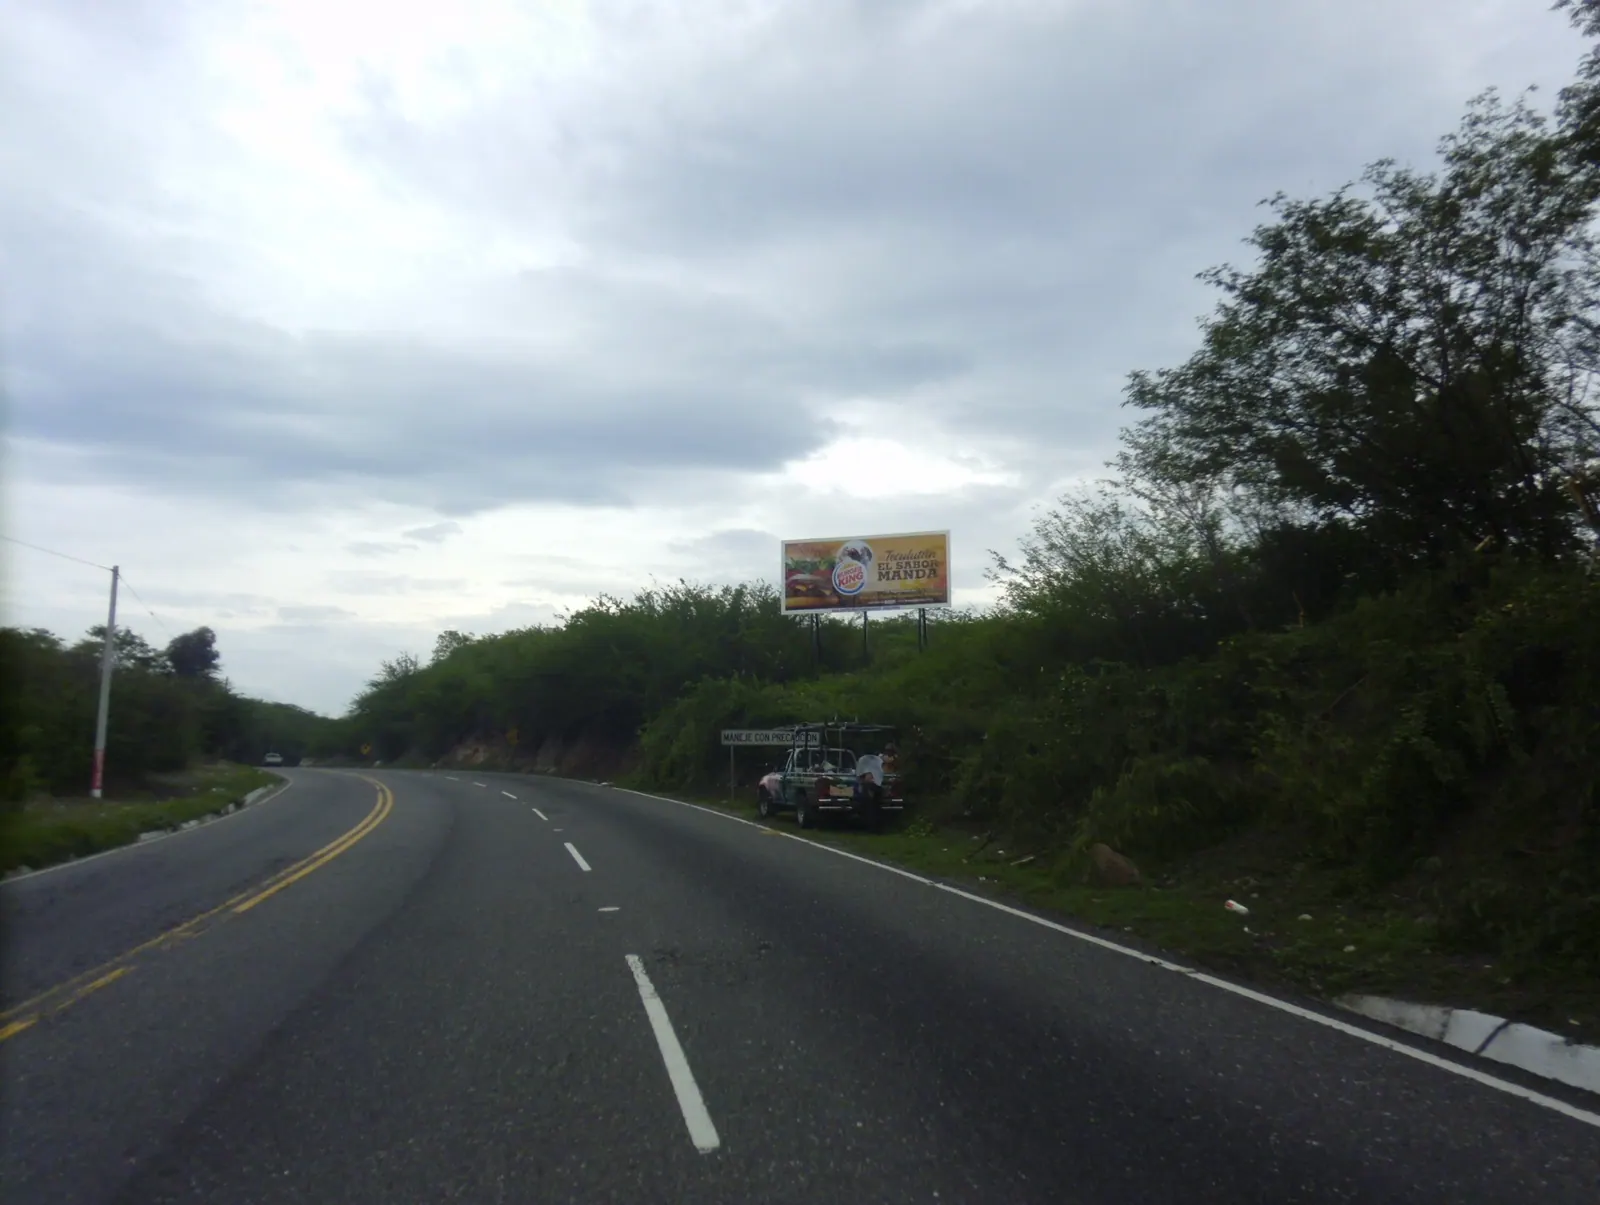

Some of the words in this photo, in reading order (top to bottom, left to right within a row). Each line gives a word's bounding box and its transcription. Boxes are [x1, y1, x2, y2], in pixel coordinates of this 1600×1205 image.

[877, 562, 893, 571] EL
[895, 559, 940, 570] SABOR
[838, 572, 864, 587] KING
[877, 568, 938, 582] MANDA
[723, 732, 753, 742] MANEJE
[754, 732, 770, 742] CON
